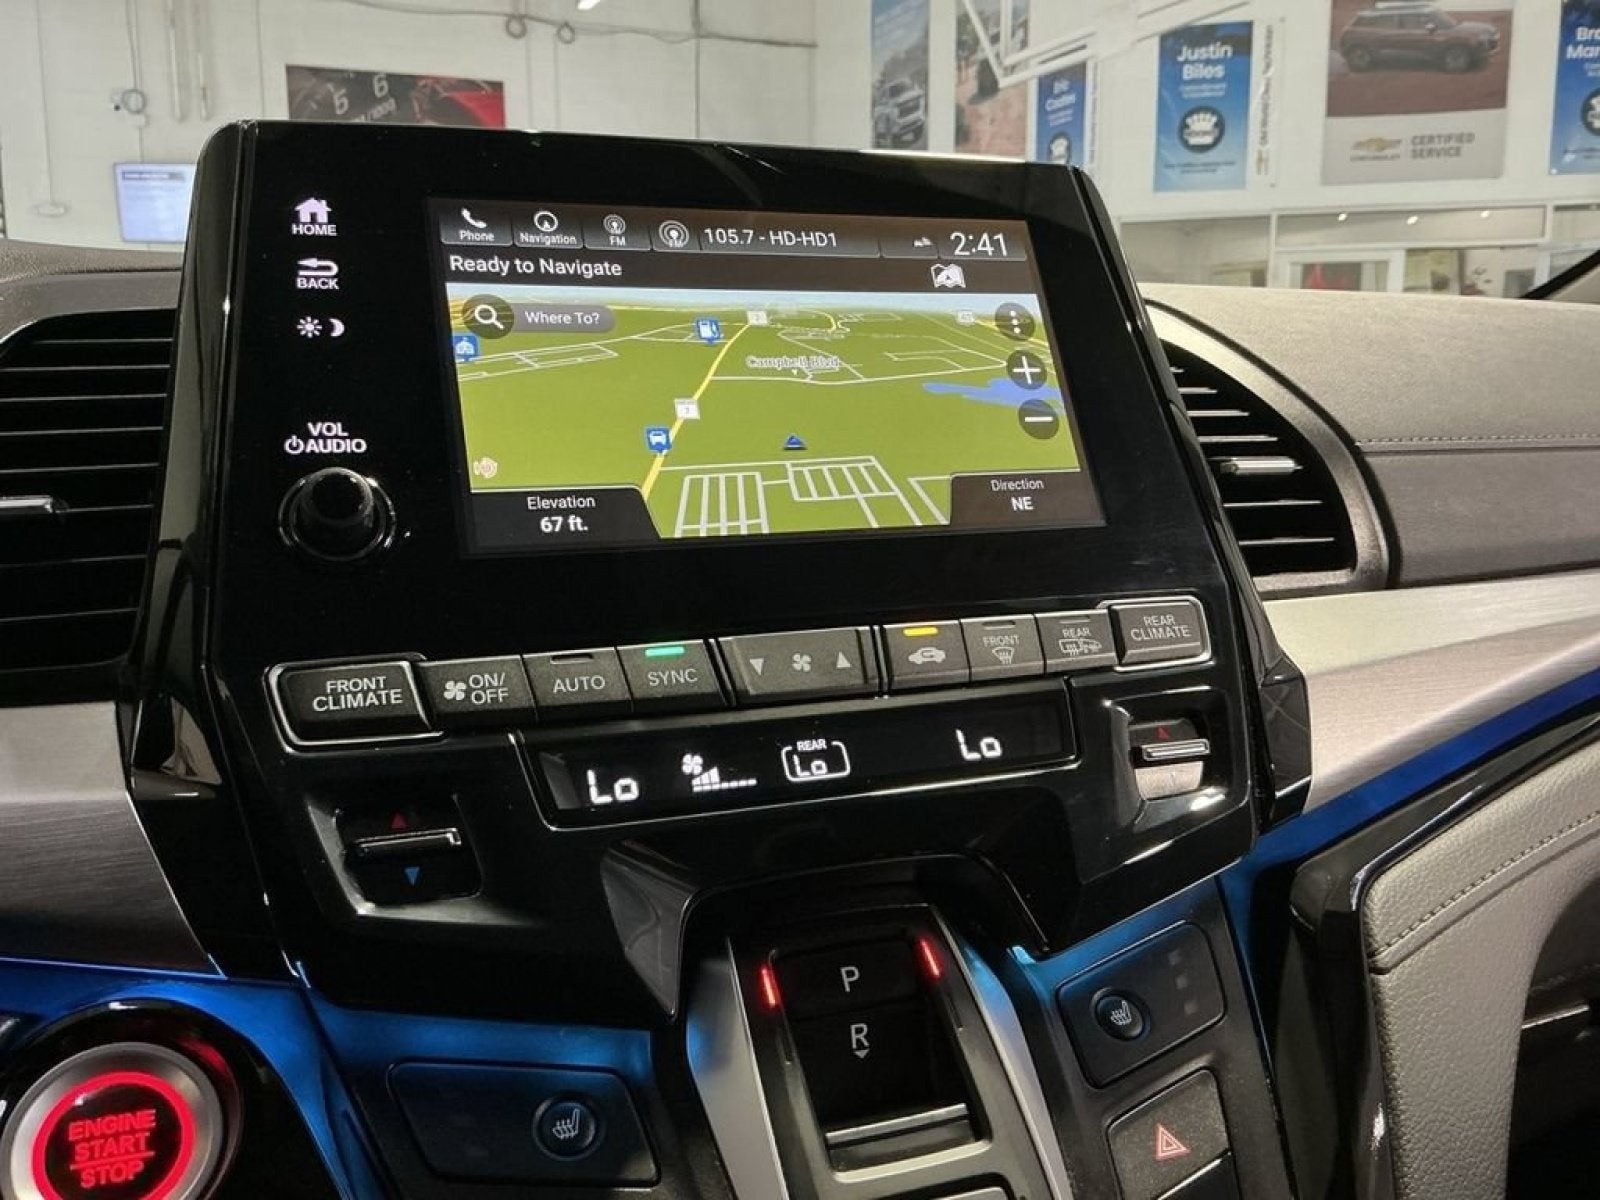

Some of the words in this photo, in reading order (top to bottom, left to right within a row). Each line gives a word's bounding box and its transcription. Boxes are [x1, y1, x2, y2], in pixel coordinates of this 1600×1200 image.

[1177, 42, 1233, 62] Justin
[1411, 132, 1475, 146] CERTIFIED
[1411, 146, 1461, 159] SERVICE
[292, 224, 337, 236] HOME
[459, 230, 495, 242] Phone
[704, 228, 754, 245] 105.7
[769, 230, 838, 248] HD-HD1
[519, 232, 577, 246] Navigation
[609, 235, 626, 247] FM
[949, 231, 1009, 257] 2:41
[450, 255, 510, 276] Ready
[515, 257, 534, 273] to
[540, 259, 622, 279] Navigate
[297, 278, 339, 289] BACK
[525, 310, 572, 324] Where
[575, 311, 600, 325] To?
[307, 422, 349, 436] VOL
[304, 438, 368, 454] AUDIO
[991, 478, 1044, 491] Direction
[527, 496, 596, 509] Elevation
[1011, 496, 1034, 511] NE
[540, 516, 563, 533] 67
[567, 515, 589, 532] ft.
[1143, 614, 1176, 627] REAR
[983, 634, 1021, 648] FRONT
[1062, 627, 1091, 638] REAR
[1130, 624, 1192, 641] CLIMATE
[326, 676, 387, 694] FRONT
[469, 672, 506, 689] ON/
[552, 676, 606, 693] AUTO
[647, 669, 698, 687] SYNC
[313, 689, 404, 711] CLIMATE
[471, 688, 509, 705] OFF
[797, 738, 828, 752] REAR
[956, 729, 1002, 761] Lo
[793, 754, 828, 776] Lo
[587, 769, 640, 805] Lo
[840, 966, 860, 993] P
[850, 1023, 869, 1050] R
[68, 1109, 156, 1141] ENGINE
[74, 1132, 150, 1161] START
[80, 1160, 144, 1189] STOP
